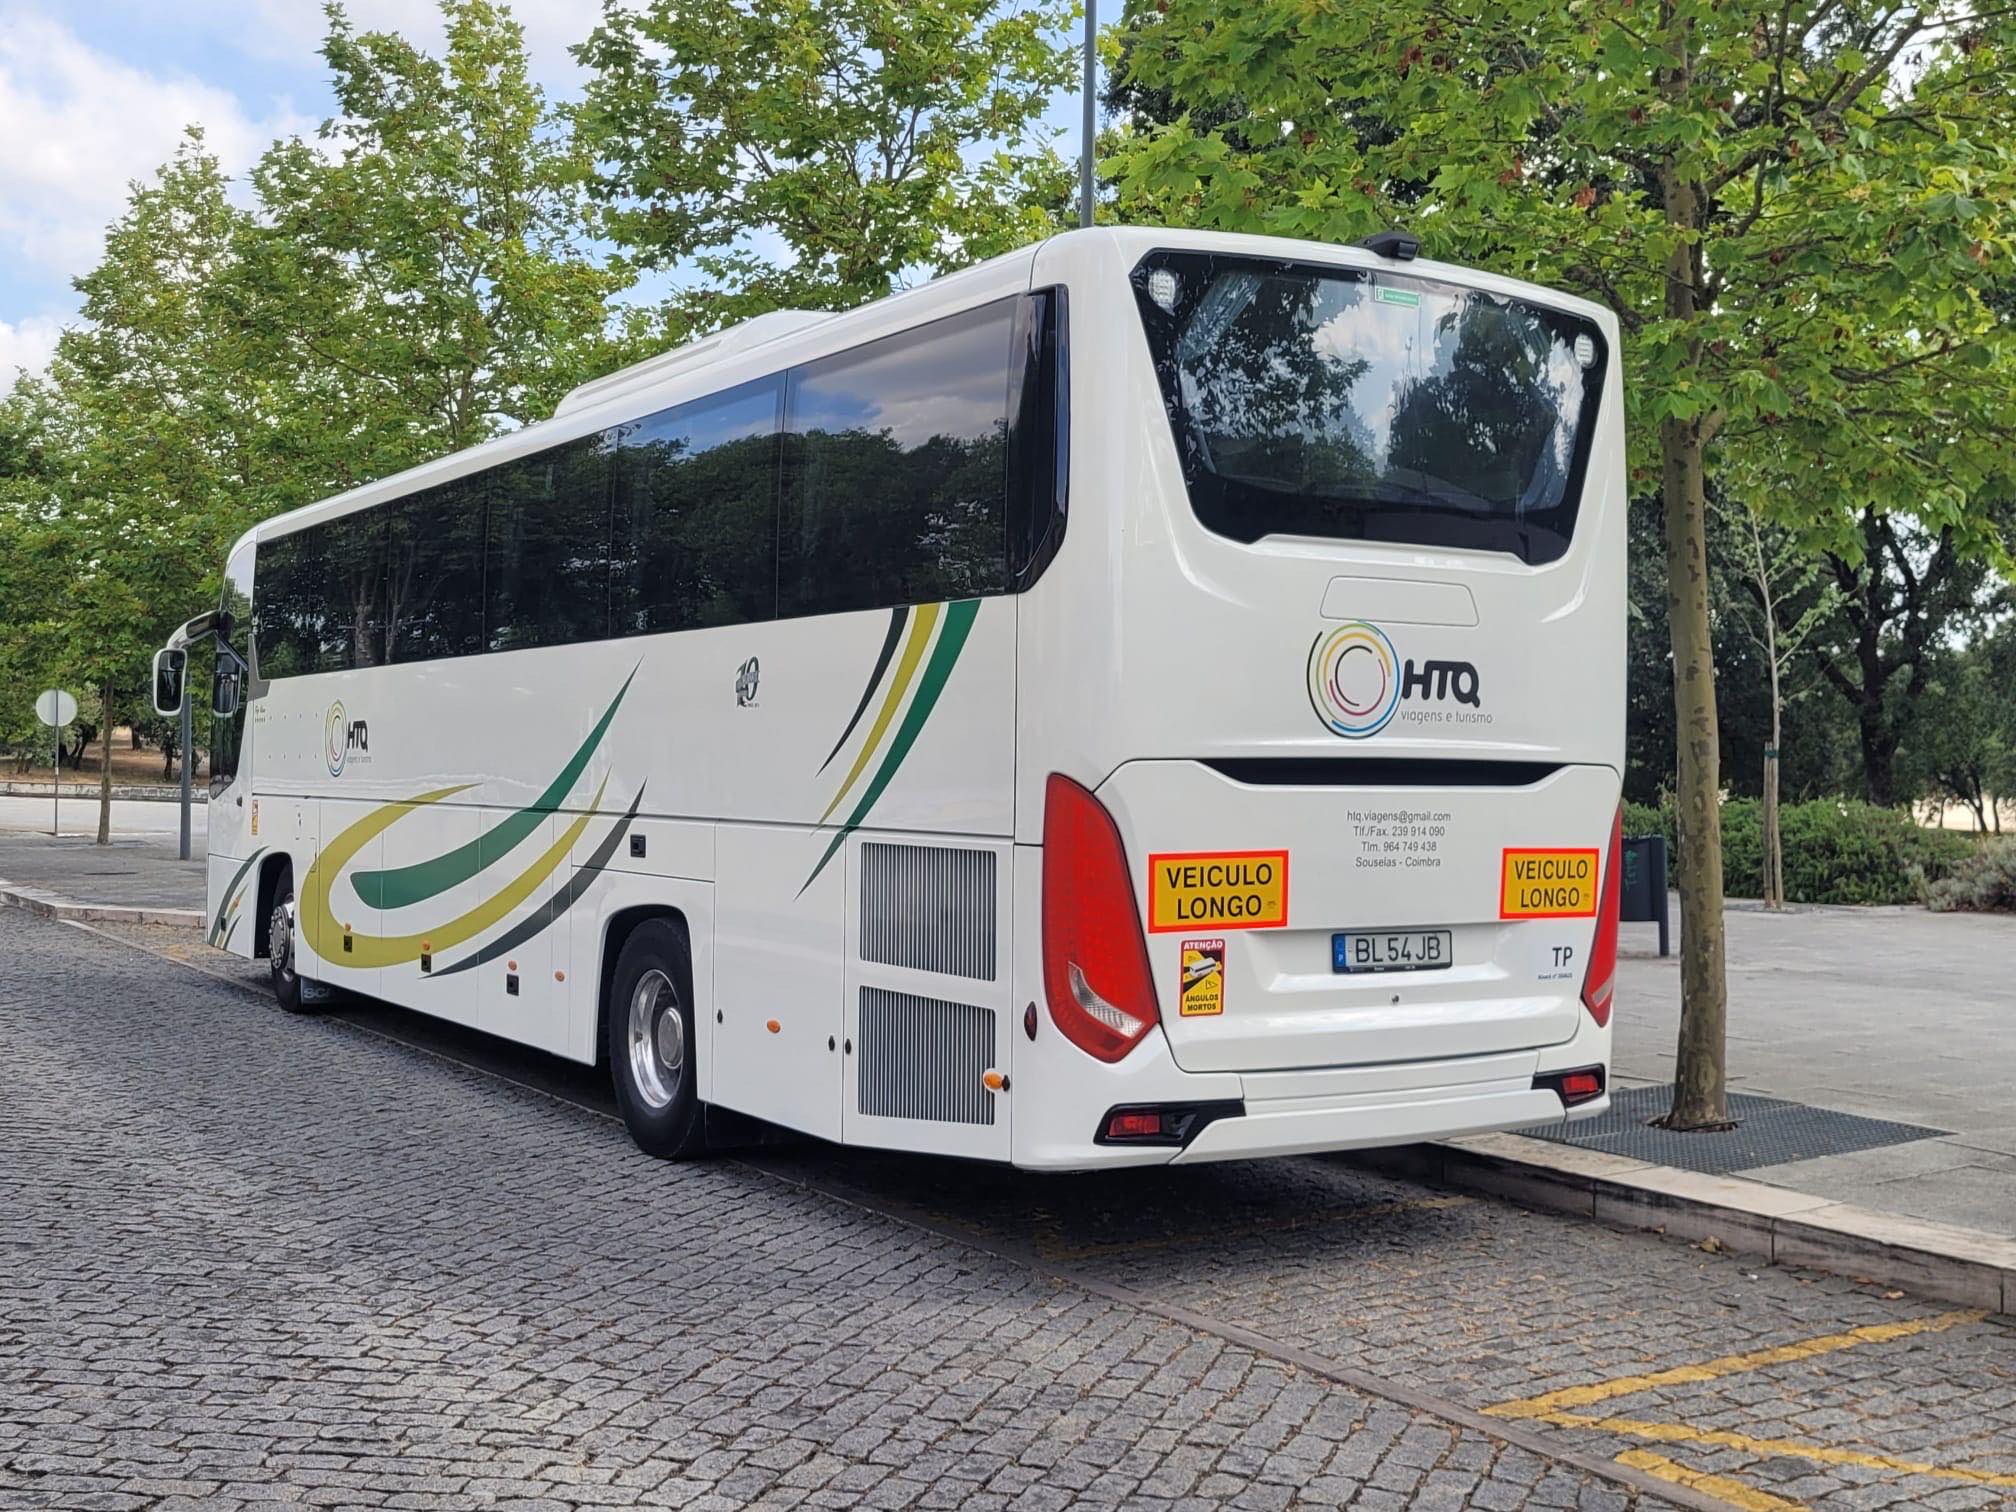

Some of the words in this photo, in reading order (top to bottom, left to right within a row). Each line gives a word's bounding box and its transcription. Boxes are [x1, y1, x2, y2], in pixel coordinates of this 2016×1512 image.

[1402, 659, 1480, 708] HTQ
[1401, 711, 1443, 725] viagens
[1446, 712, 1452, 722] e
[1456, 711, 1493, 723] turismo
[347, 720, 368, 753] HTQ
[1346, 810, 1451, 823] htq.viagens@gmail.com
[1392, 826, 1408, 836] 239
[1411, 826, 1426, 836] 914
[1429, 826, 1445, 836] 090
[1383, 841, 1399, 851] 964
[1402, 841, 1419, 851] 749
[1420, 841, 1437, 851] 438
[1355, 857, 1397, 867] Souselas
[1405, 856, 1441, 867] Coimbra
[1166, 863, 1273, 889] VEICULO
[1514, 860, 1588, 880] VEICULO
[1521, 887, 1580, 908] LONGO
[1177, 895, 1262, 920] LONGO
[1184, 941, 1223, 950] ATENÇÃO
[1552, 946, 1573, 967] TP
[1186, 993, 1219, 1002] ÂNGULOS
[1187, 1003, 1216, 1011] MORTOS
